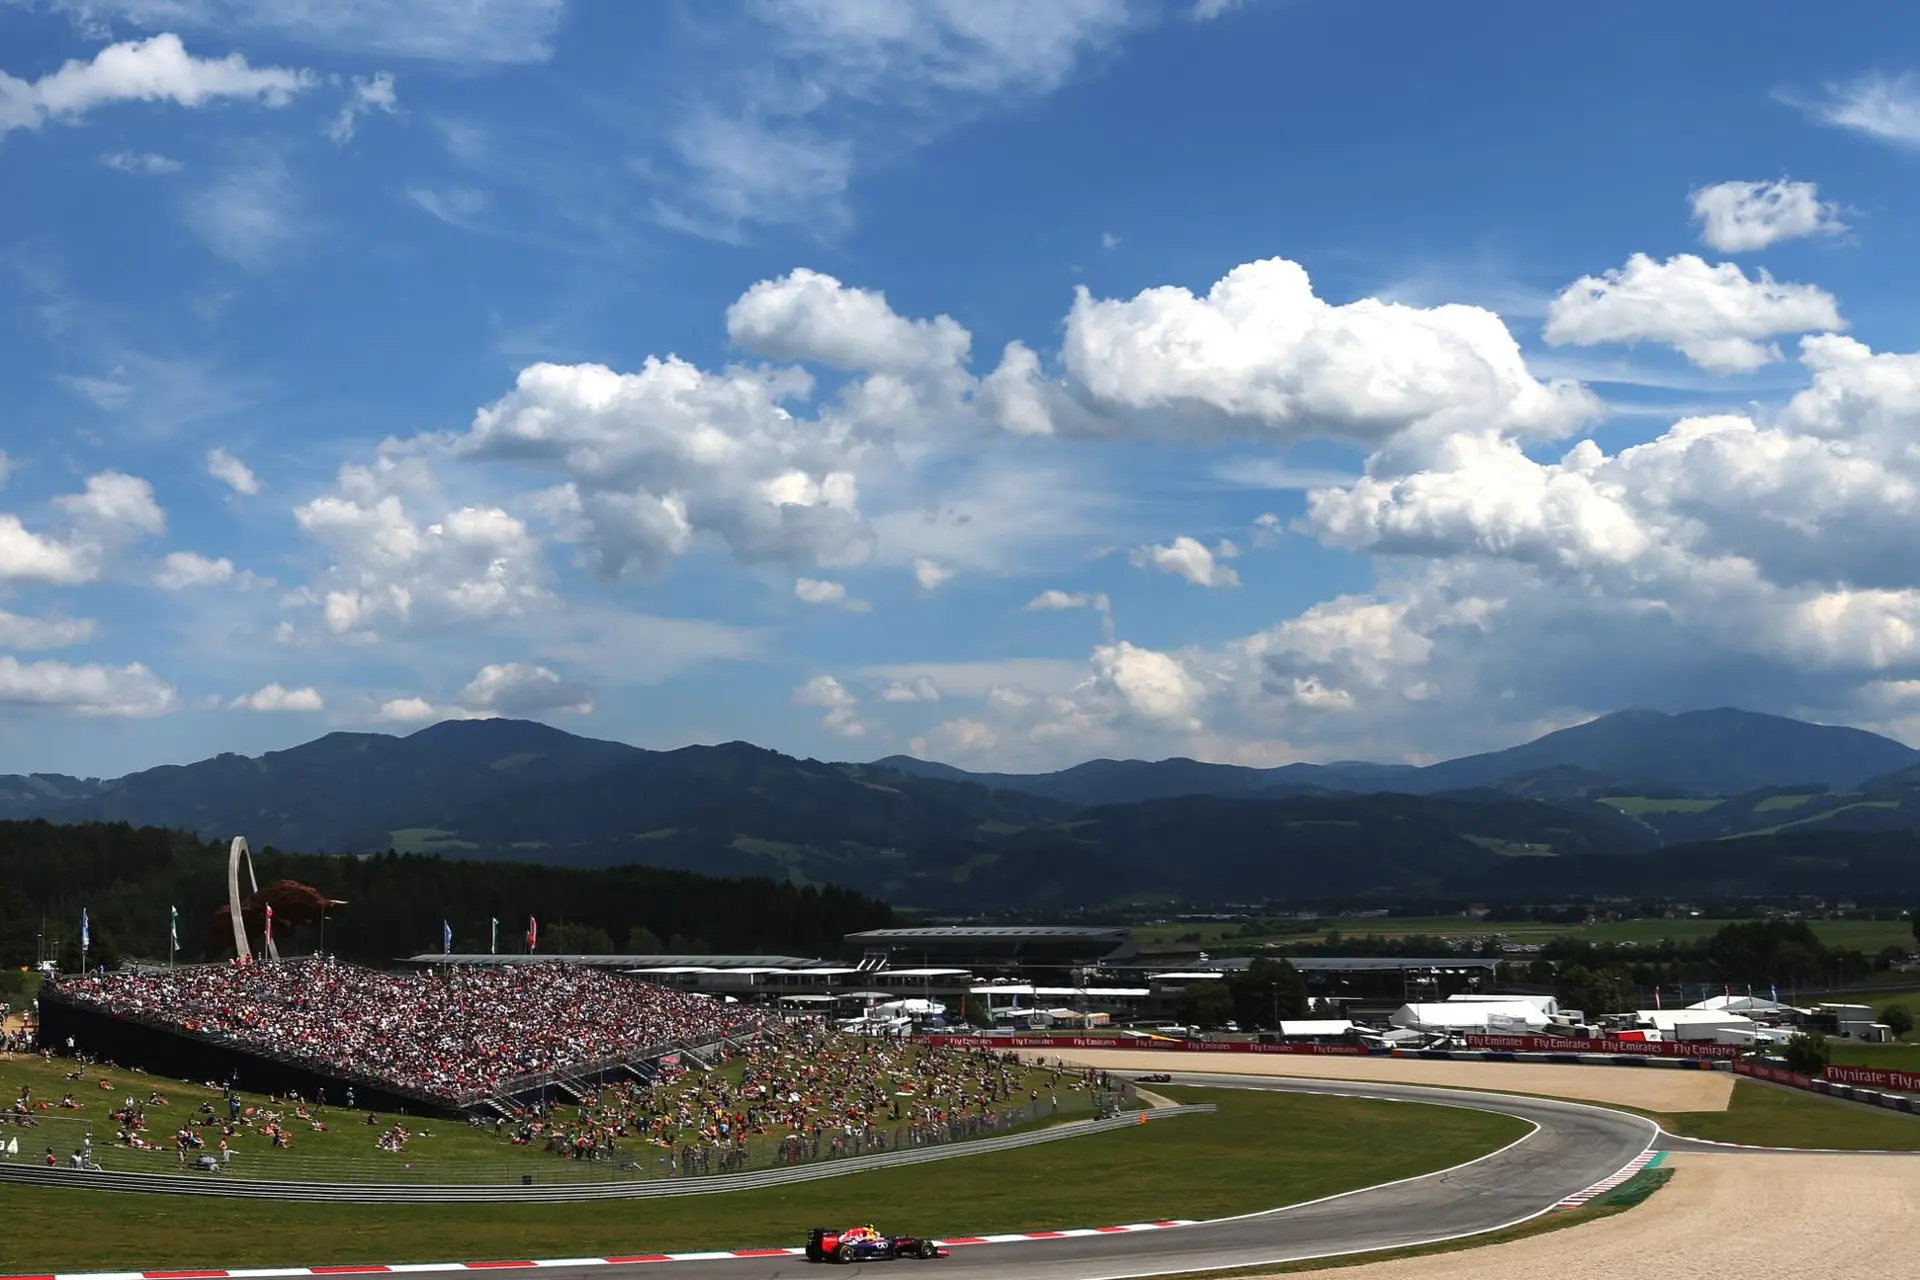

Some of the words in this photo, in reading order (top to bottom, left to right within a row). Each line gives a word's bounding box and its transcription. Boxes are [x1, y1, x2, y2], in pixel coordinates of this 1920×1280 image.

[1011, 1038, 1023, 1047] Fly
[1024, 1038, 1054, 1046] Emirates
[1074, 1038, 1086, 1047] Fly
[1086, 1038, 1117, 1046] Emirates
[1136, 1039, 1148, 1048] Fly
[1469, 1036, 1483, 1046] Fly
[1485, 1036, 1523, 1046] Emirates
[1533, 1038, 1549, 1048] Fly
[1550, 1038, 1590, 1049] Emirates
[1188, 1042, 1200, 1051] Fly
[1200, 1042, 1231, 1050] Emirates
[1250, 1043, 1262, 1052] Fly
[1263, 1043, 1294, 1052] Emirates
[1313, 1045, 1325, 1054] Fly
[1326, 1045, 1357, 1053] Emirates
[1602, 1040, 1618, 1051] Fly
[1620, 1041, 1662, 1053] Emirates
[1673, 1043, 1691, 1055] Fly
[1692, 1044, 1737, 1056] Emirates
[1827, 1067, 1847, 1081] Fly
[1890, 1073, 1912, 1089] Fly
